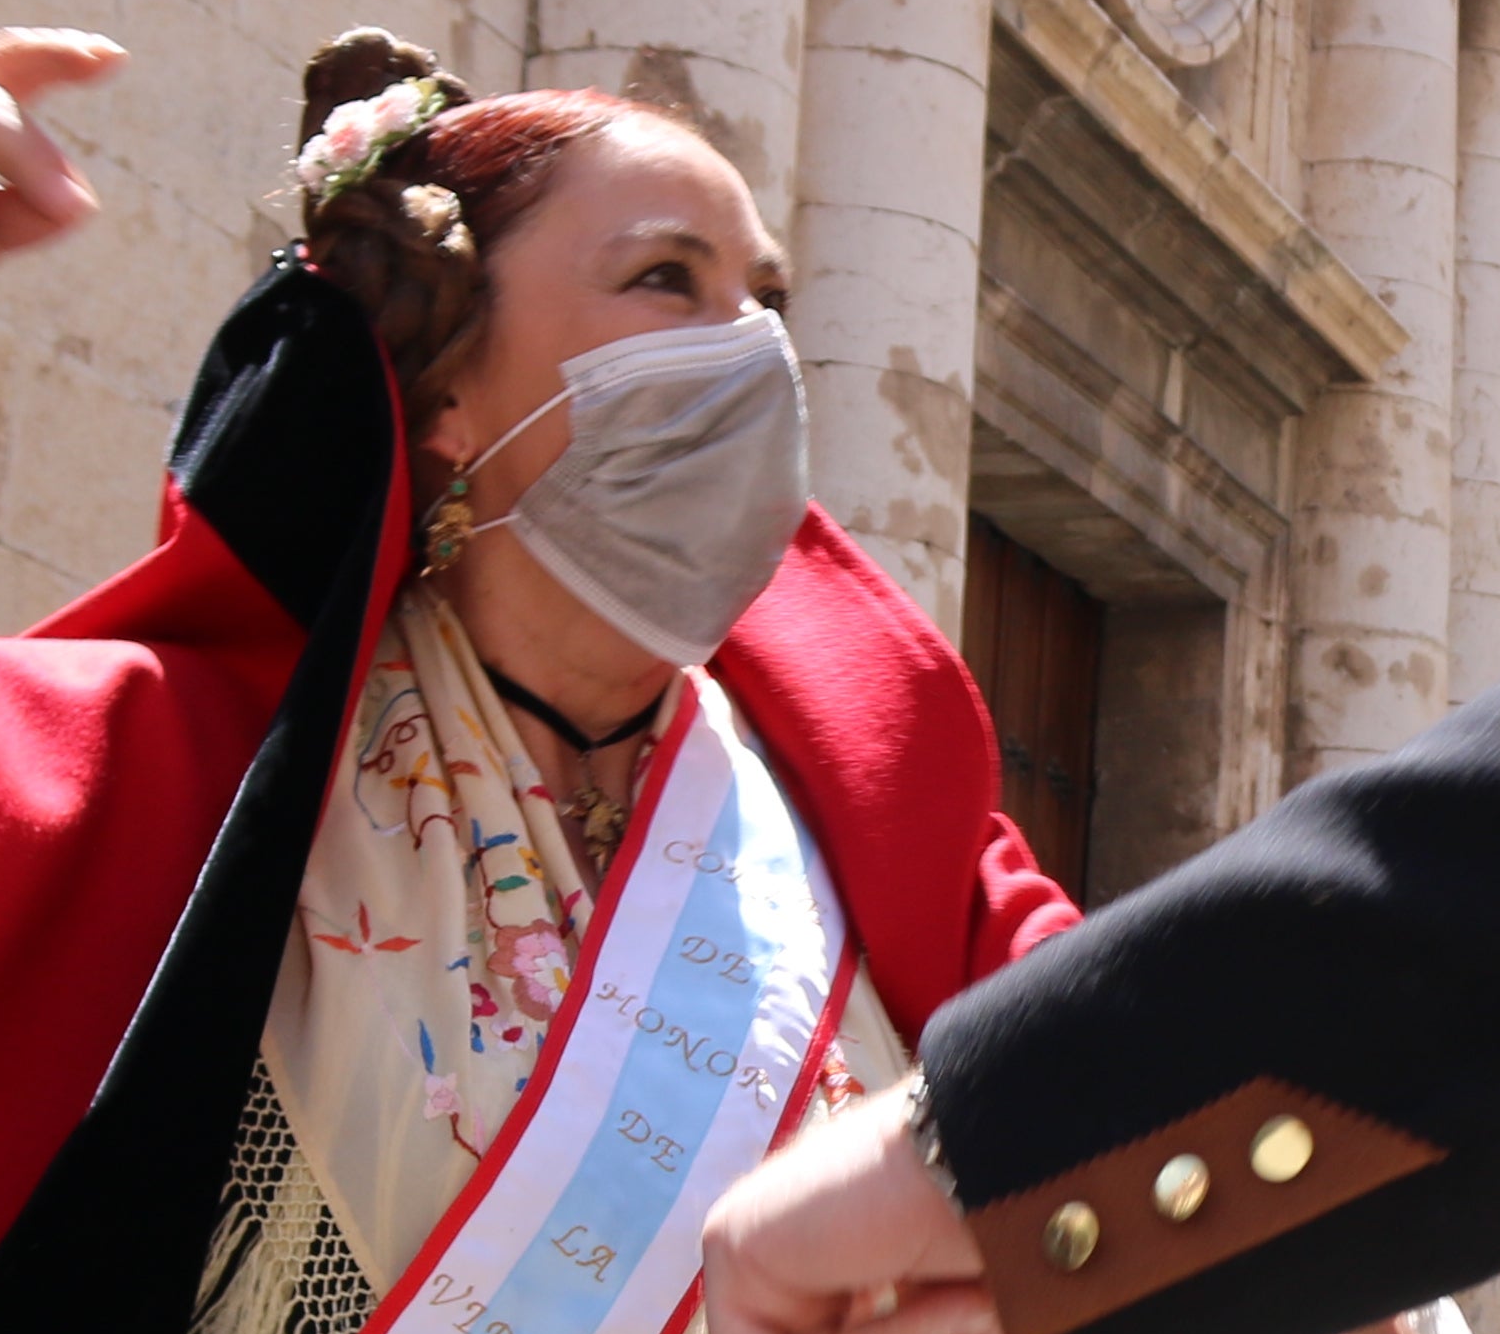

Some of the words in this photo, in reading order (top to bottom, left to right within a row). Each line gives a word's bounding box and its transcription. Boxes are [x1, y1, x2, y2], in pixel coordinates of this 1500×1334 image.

[678, 935, 752, 985] DE
[595, 981, 770, 1111] HONOR
[617, 1109, 686, 1173] DE
[550, 1224, 618, 1283] LA
